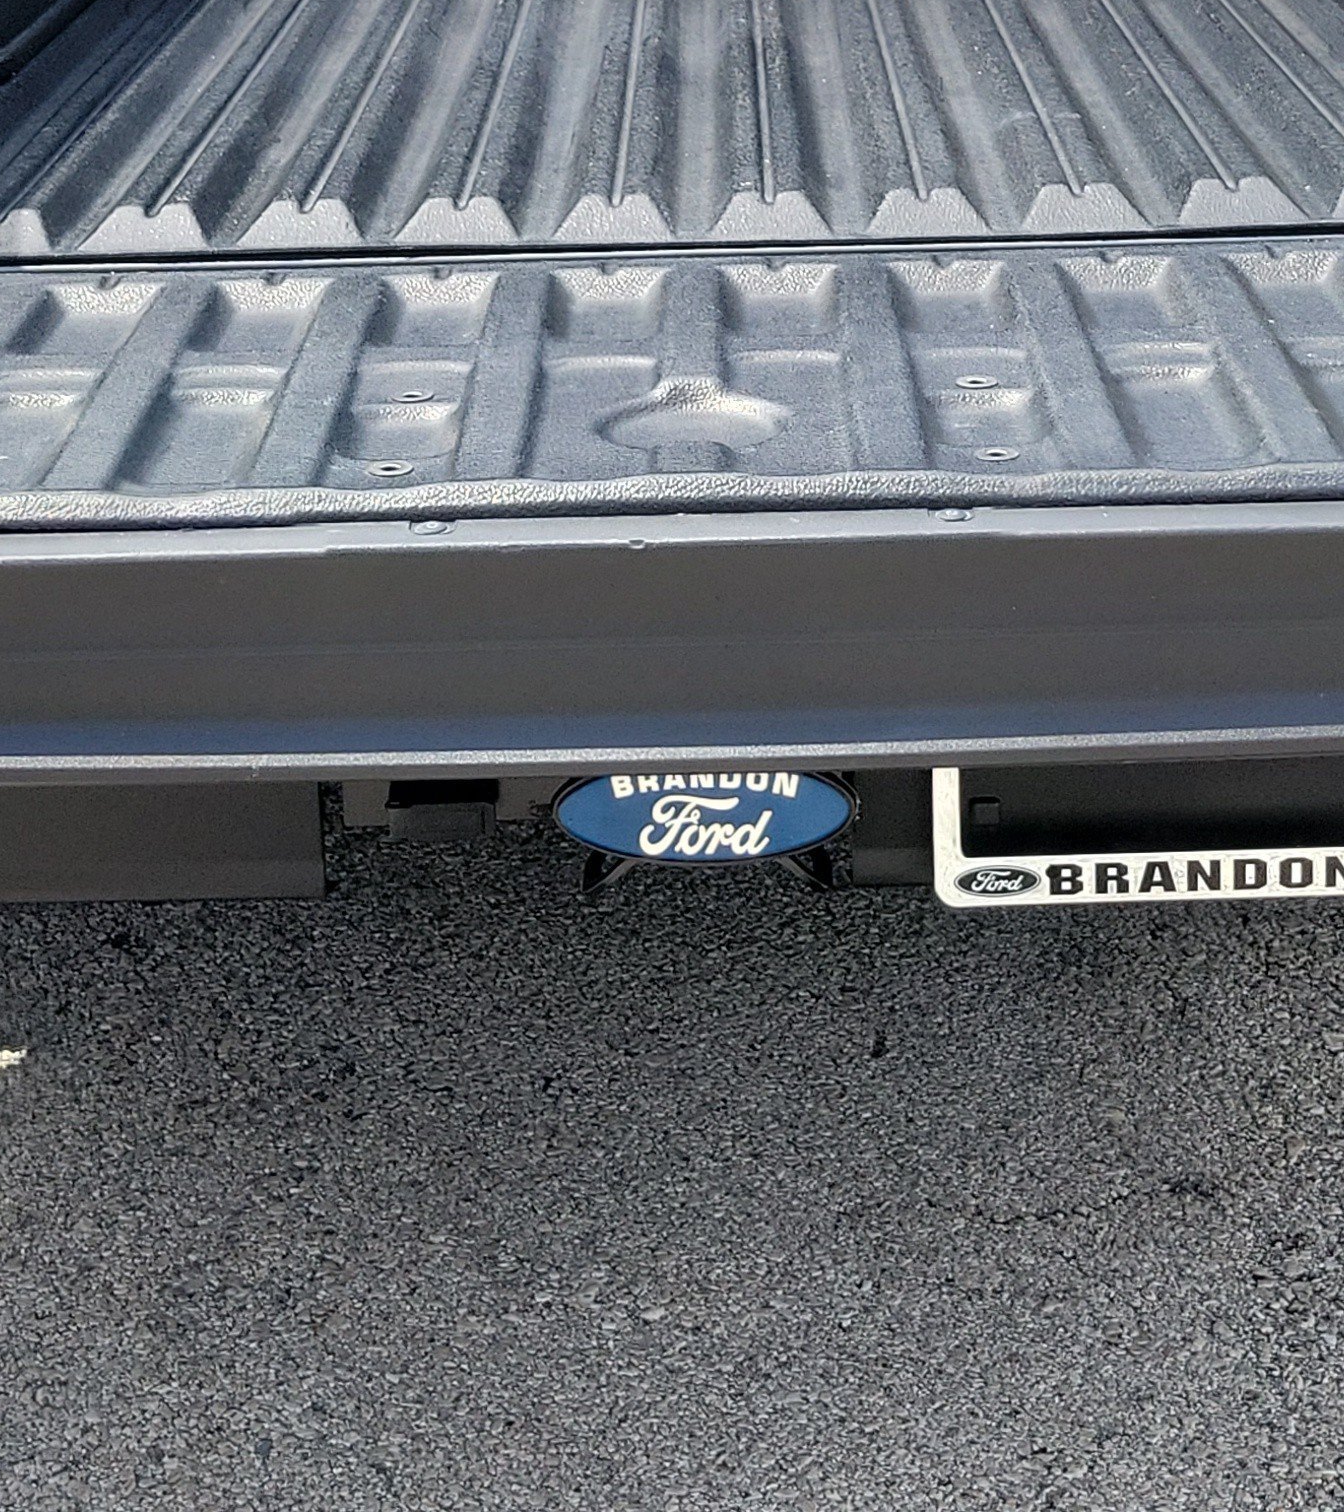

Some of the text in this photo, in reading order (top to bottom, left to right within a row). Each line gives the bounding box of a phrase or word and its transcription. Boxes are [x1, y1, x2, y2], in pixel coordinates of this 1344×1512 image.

[610, 772, 800, 799] BRANDON
[639, 794, 773, 856] Ford
[970, 870, 1024, 893] Ford
